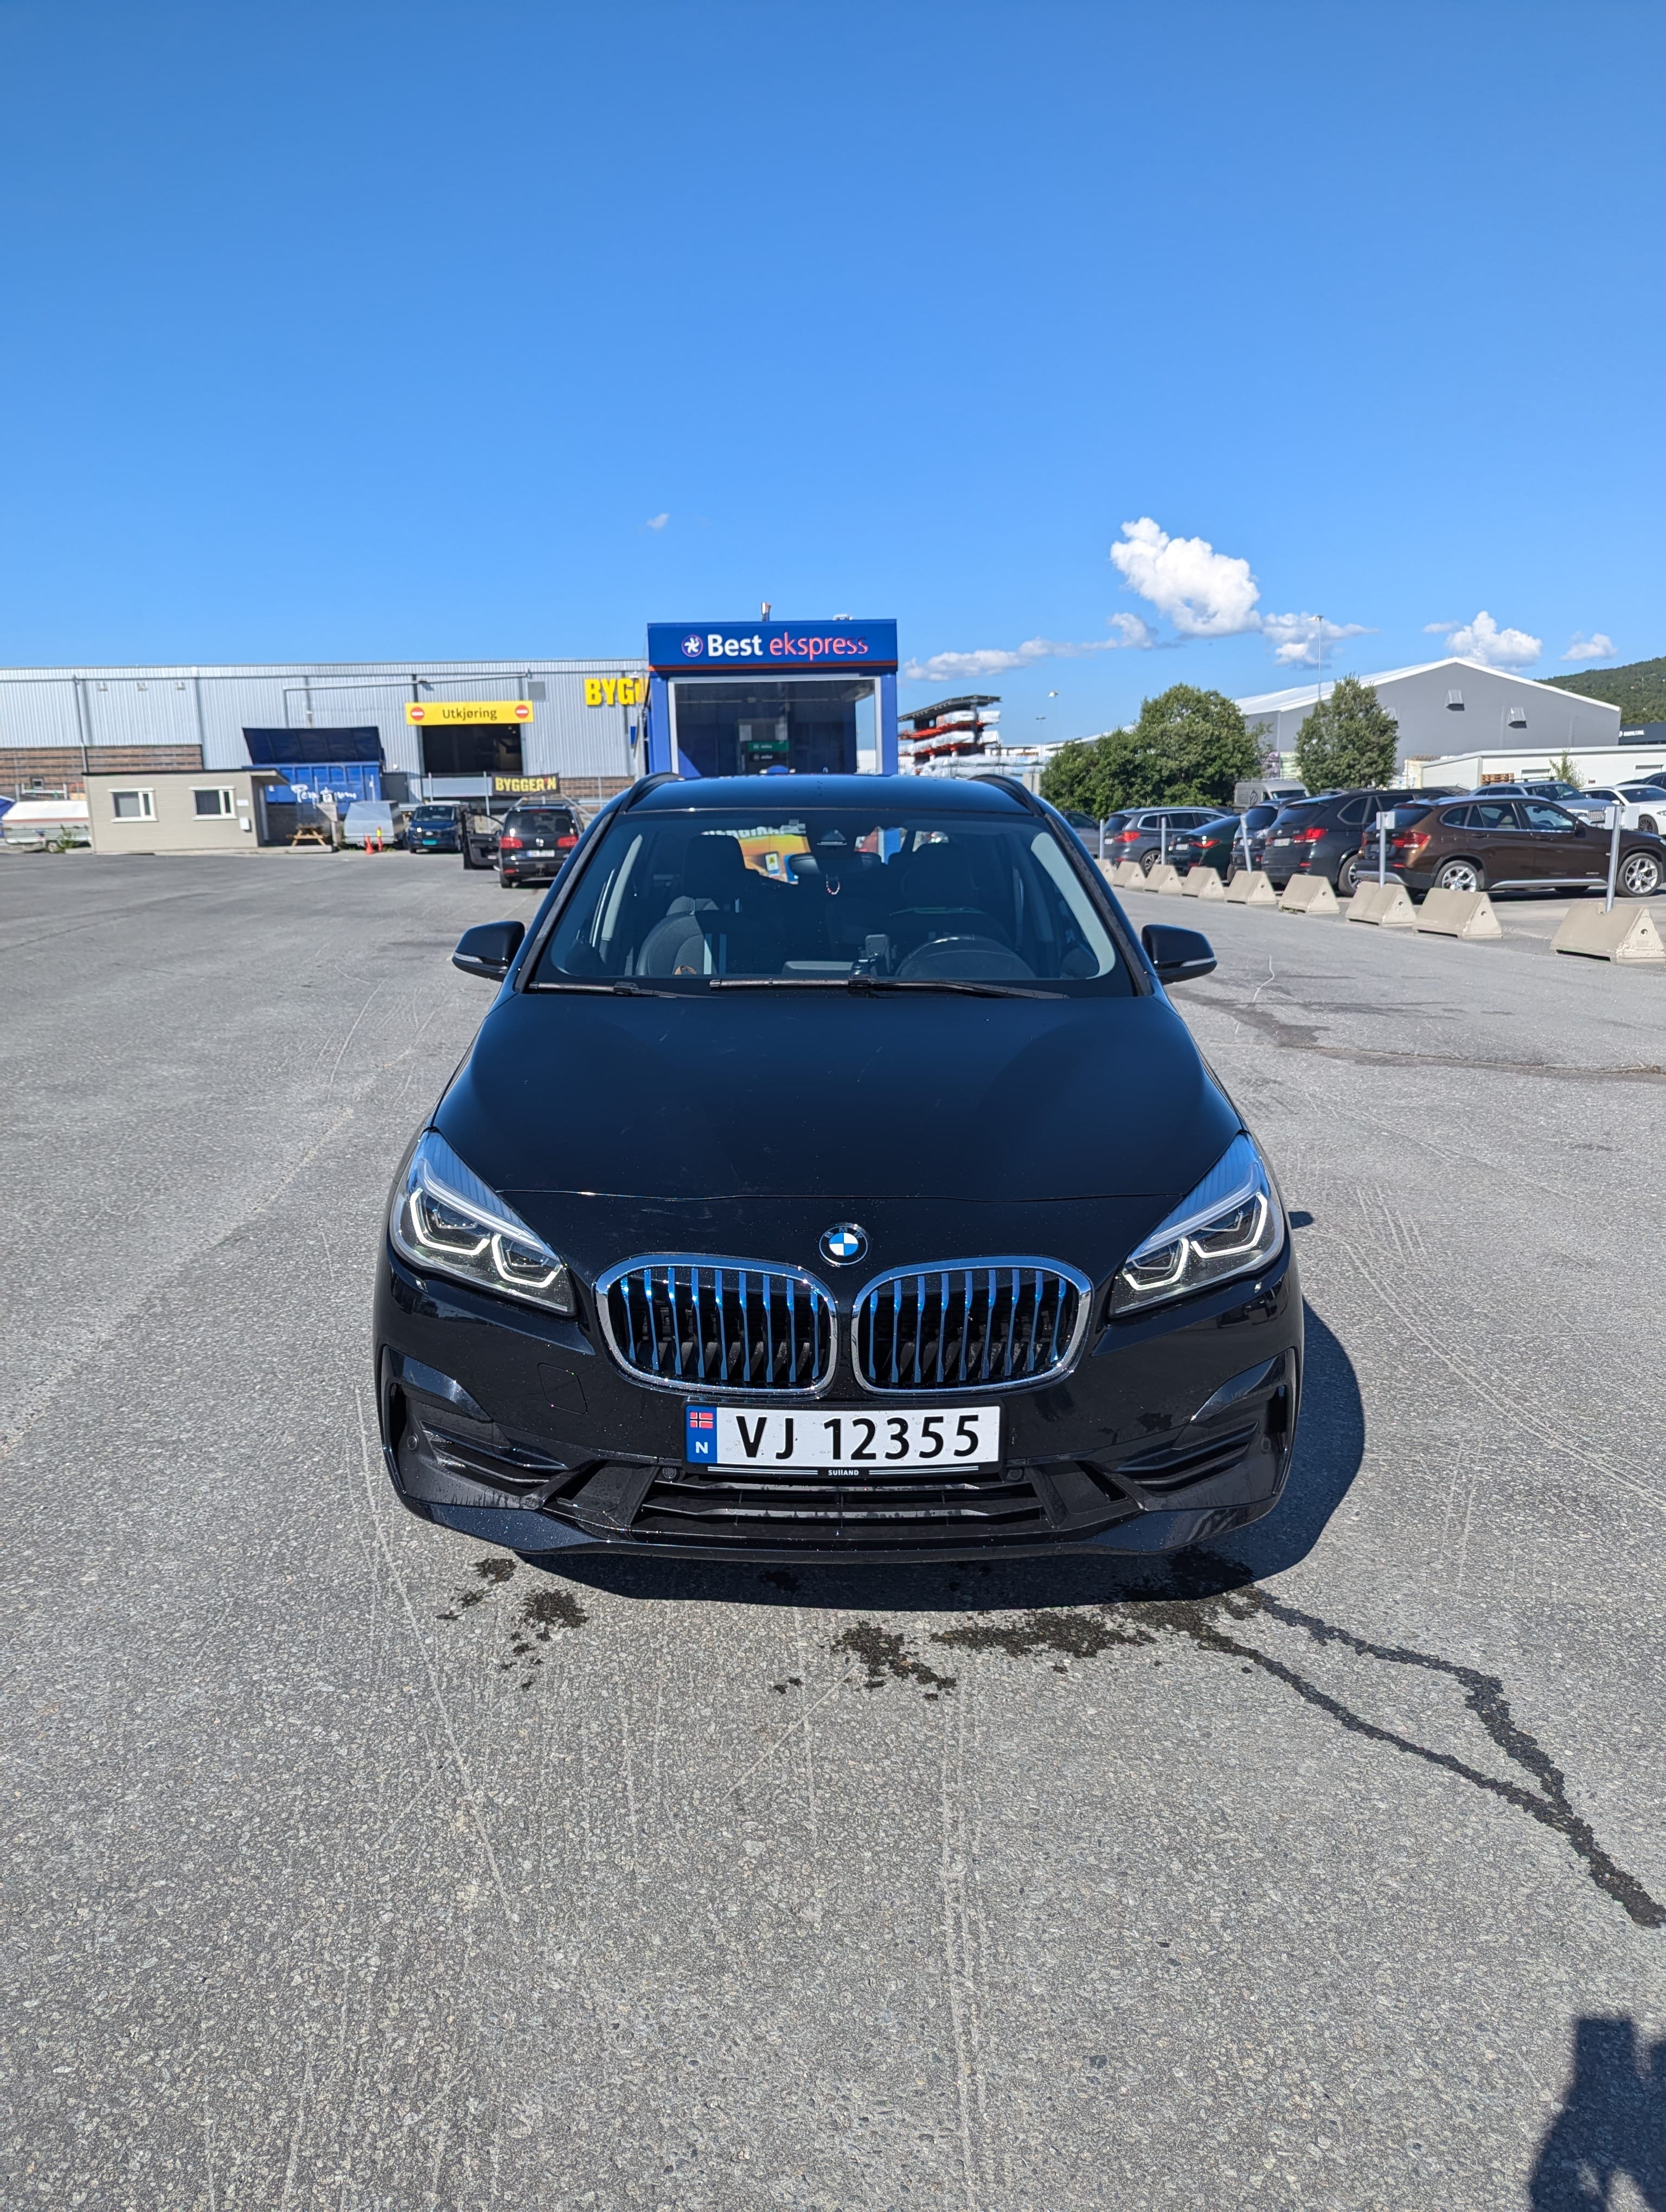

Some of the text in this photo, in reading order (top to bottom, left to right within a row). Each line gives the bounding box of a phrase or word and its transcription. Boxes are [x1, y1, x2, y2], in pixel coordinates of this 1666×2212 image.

[707, 631, 869, 661] Best ekspress
[442, 707, 498, 721] Utkjøring
[824, 1226, 863, 1239] BMW
[735, 1414, 979, 1461] VJ 12355
[695, 1441, 708, 1454] N
